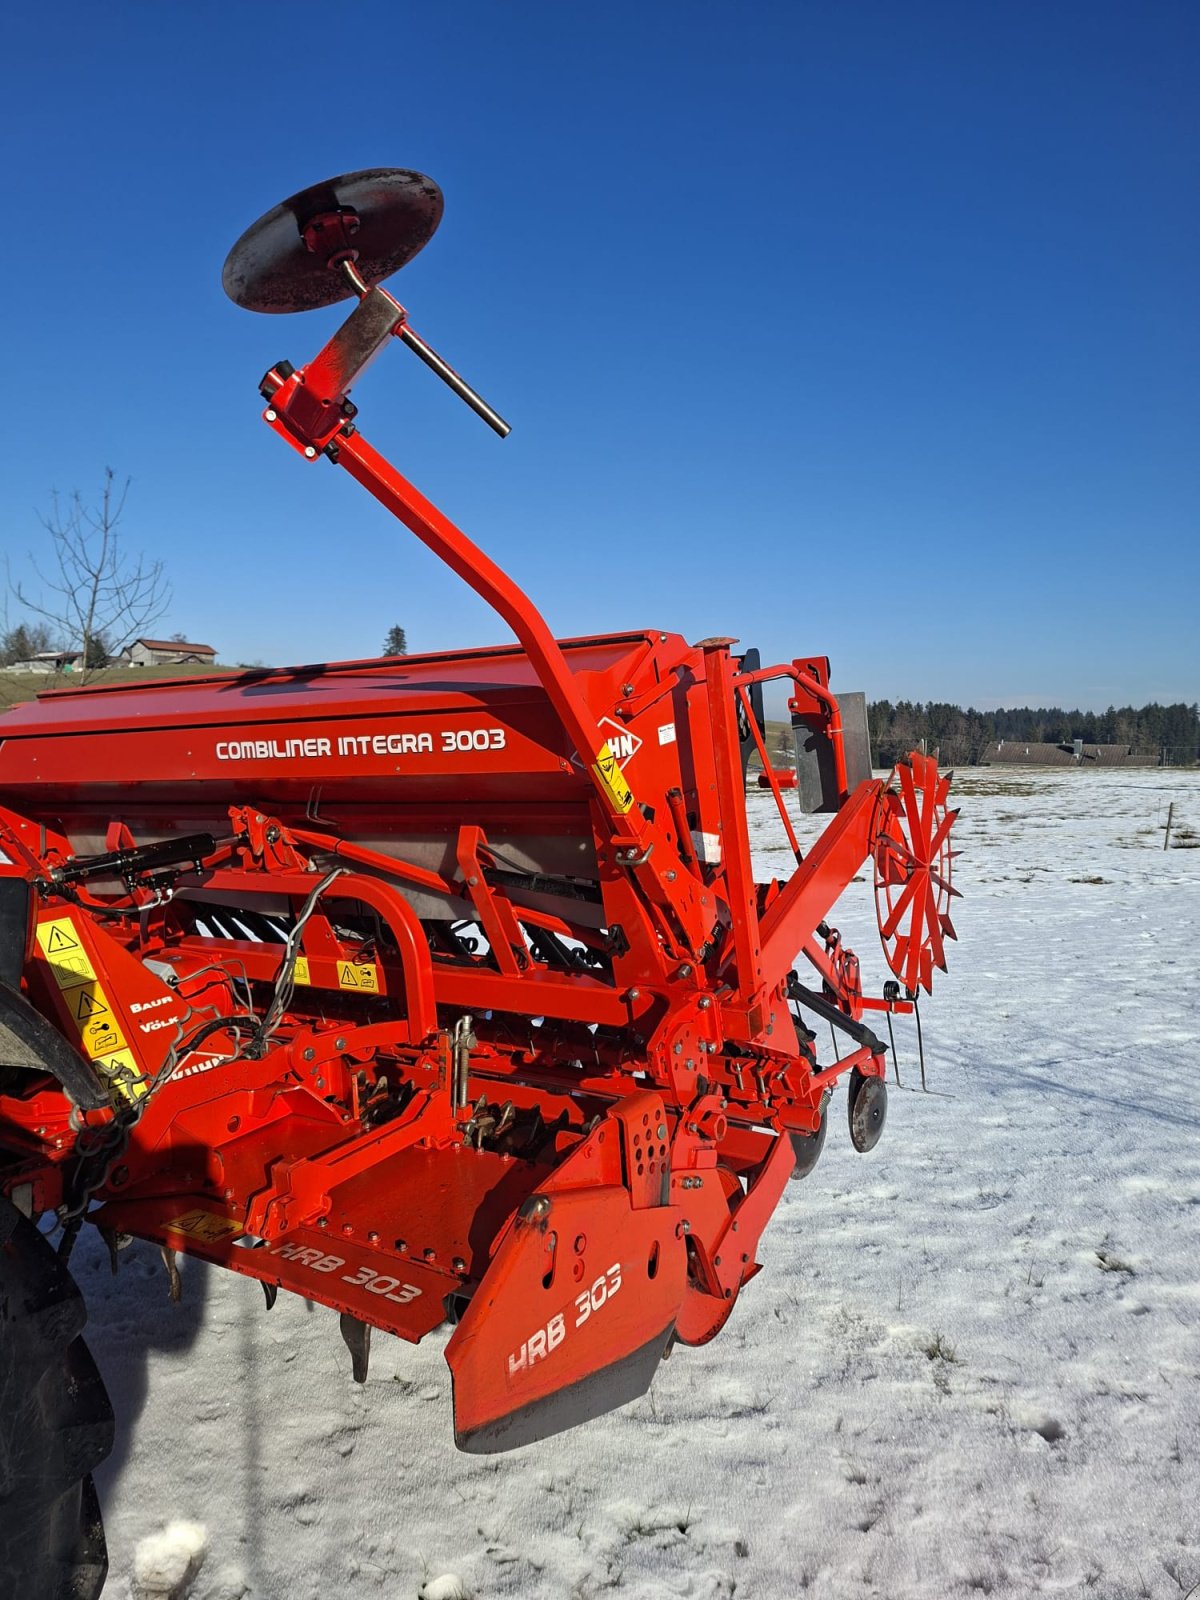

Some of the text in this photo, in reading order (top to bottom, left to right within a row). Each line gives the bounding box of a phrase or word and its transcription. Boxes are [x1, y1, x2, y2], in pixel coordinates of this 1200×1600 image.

[216, 728, 507, 760] COMBILINER INTEGRA 3003
[606, 734, 634, 759] HN
[270, 1242, 423, 1304] HRB 303
[508, 1262, 622, 1376] HRB 303
